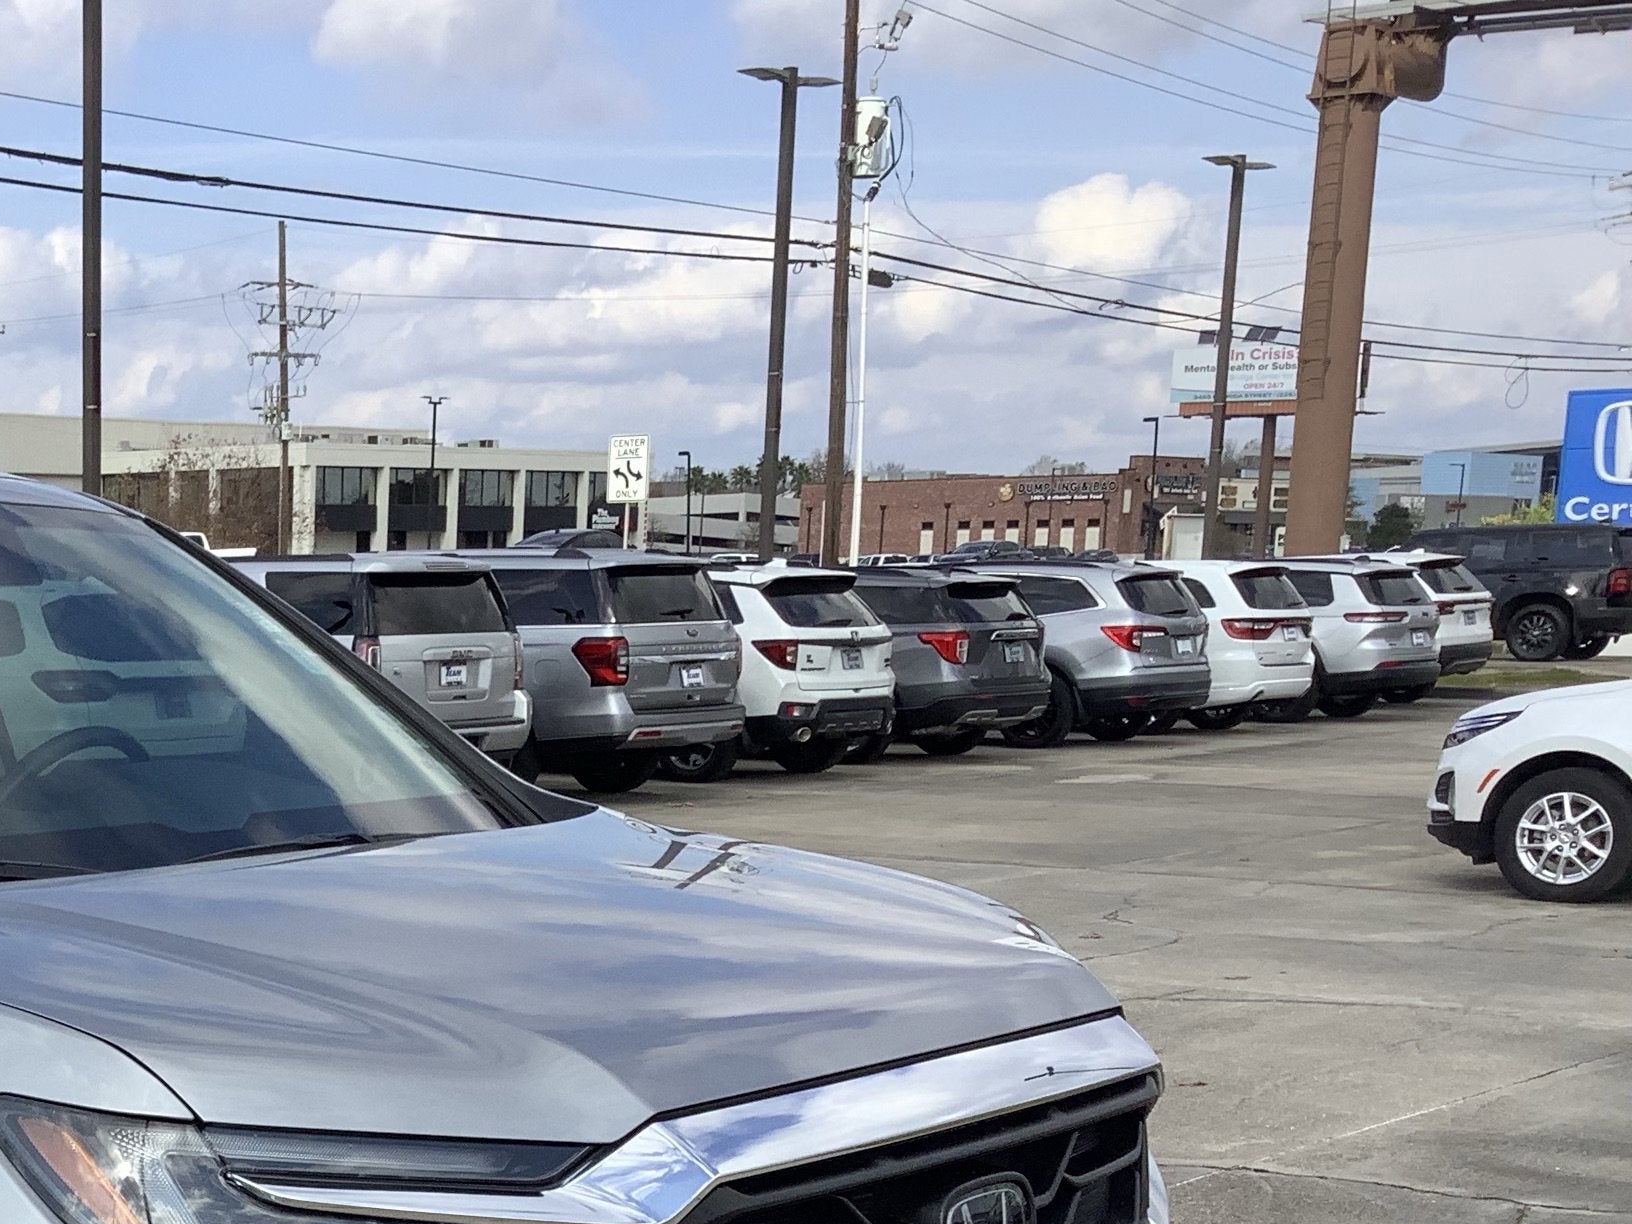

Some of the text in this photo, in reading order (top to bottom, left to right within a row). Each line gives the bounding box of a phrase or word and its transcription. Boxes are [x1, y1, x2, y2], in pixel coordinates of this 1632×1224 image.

[1231, 349, 1244, 360] In
[1184, 362, 1297, 373] Menta ealth or Subs
[613, 438, 645, 447] CENTER
[618, 448, 639, 456] LANE
[1018, 482, 1078, 493] DUMPING
[1093, 481, 1116, 492] BAO
[616, 490, 638, 498] ONLY
[1564, 497, 1632, 521] Cer
[446, 666, 462, 677] TEAM
